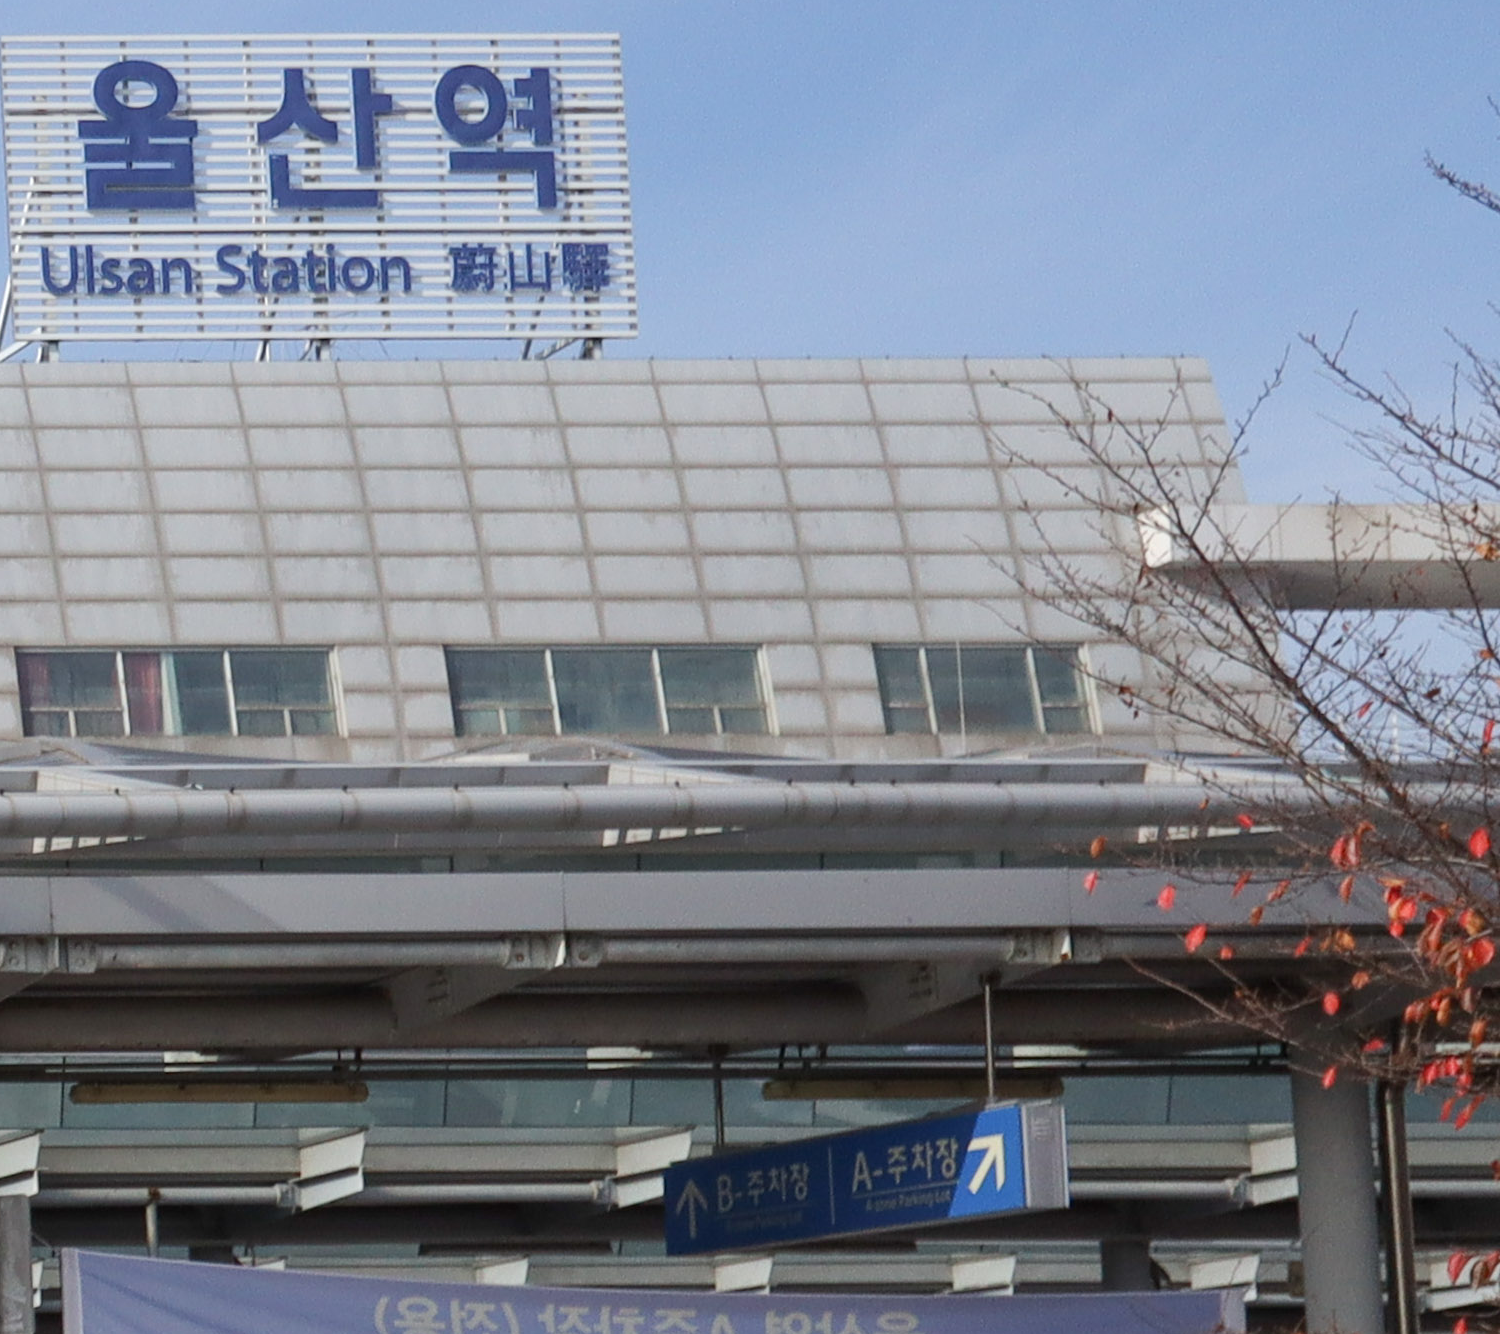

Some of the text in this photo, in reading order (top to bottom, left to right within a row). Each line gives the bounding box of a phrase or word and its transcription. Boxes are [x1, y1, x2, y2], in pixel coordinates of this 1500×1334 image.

[76, 59, 560, 212] 울산역
[39, 242, 612, 296] Ulsan Station 蔚山驛
